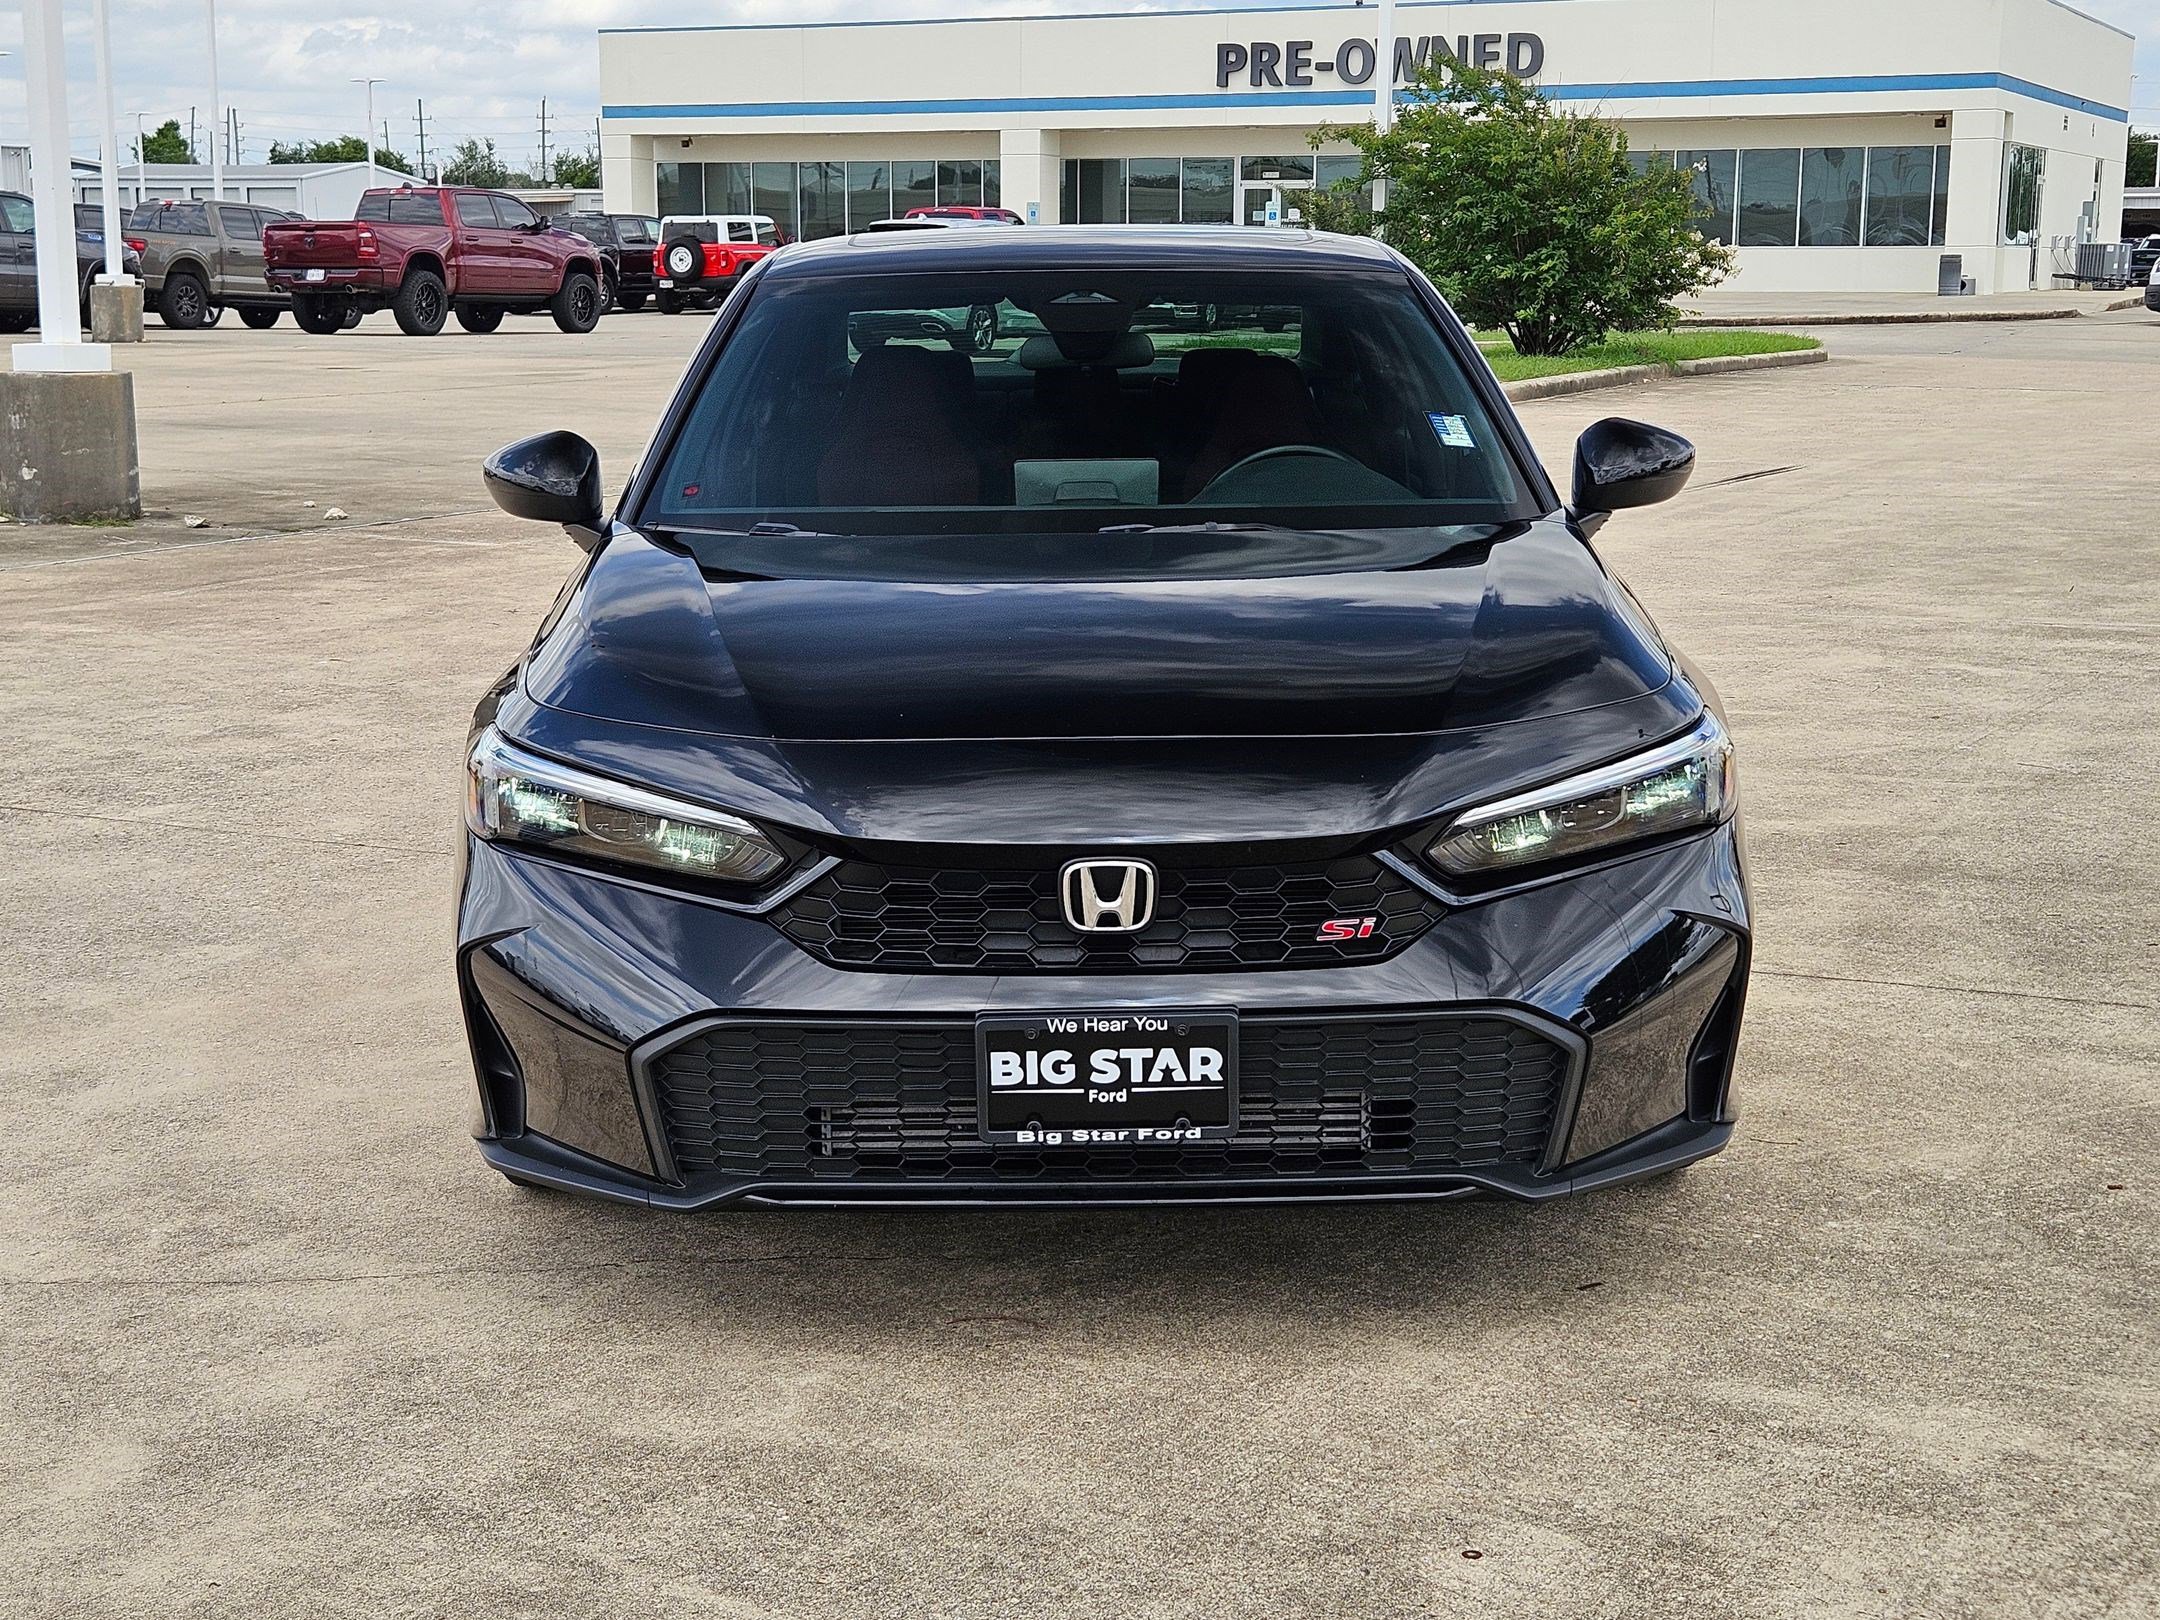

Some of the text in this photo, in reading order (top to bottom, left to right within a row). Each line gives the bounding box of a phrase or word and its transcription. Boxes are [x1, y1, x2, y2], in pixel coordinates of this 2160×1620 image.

[1216, 32, 1545, 87] PRE-OWNED
[1316, 917, 1377, 941] Si
[1047, 1016, 1168, 1033] We Hear You
[990, 1047, 1224, 1086] BIG STAR
[1088, 1088, 1127, 1103] Ford
[1016, 1127, 1202, 1144] Big Star Ford
